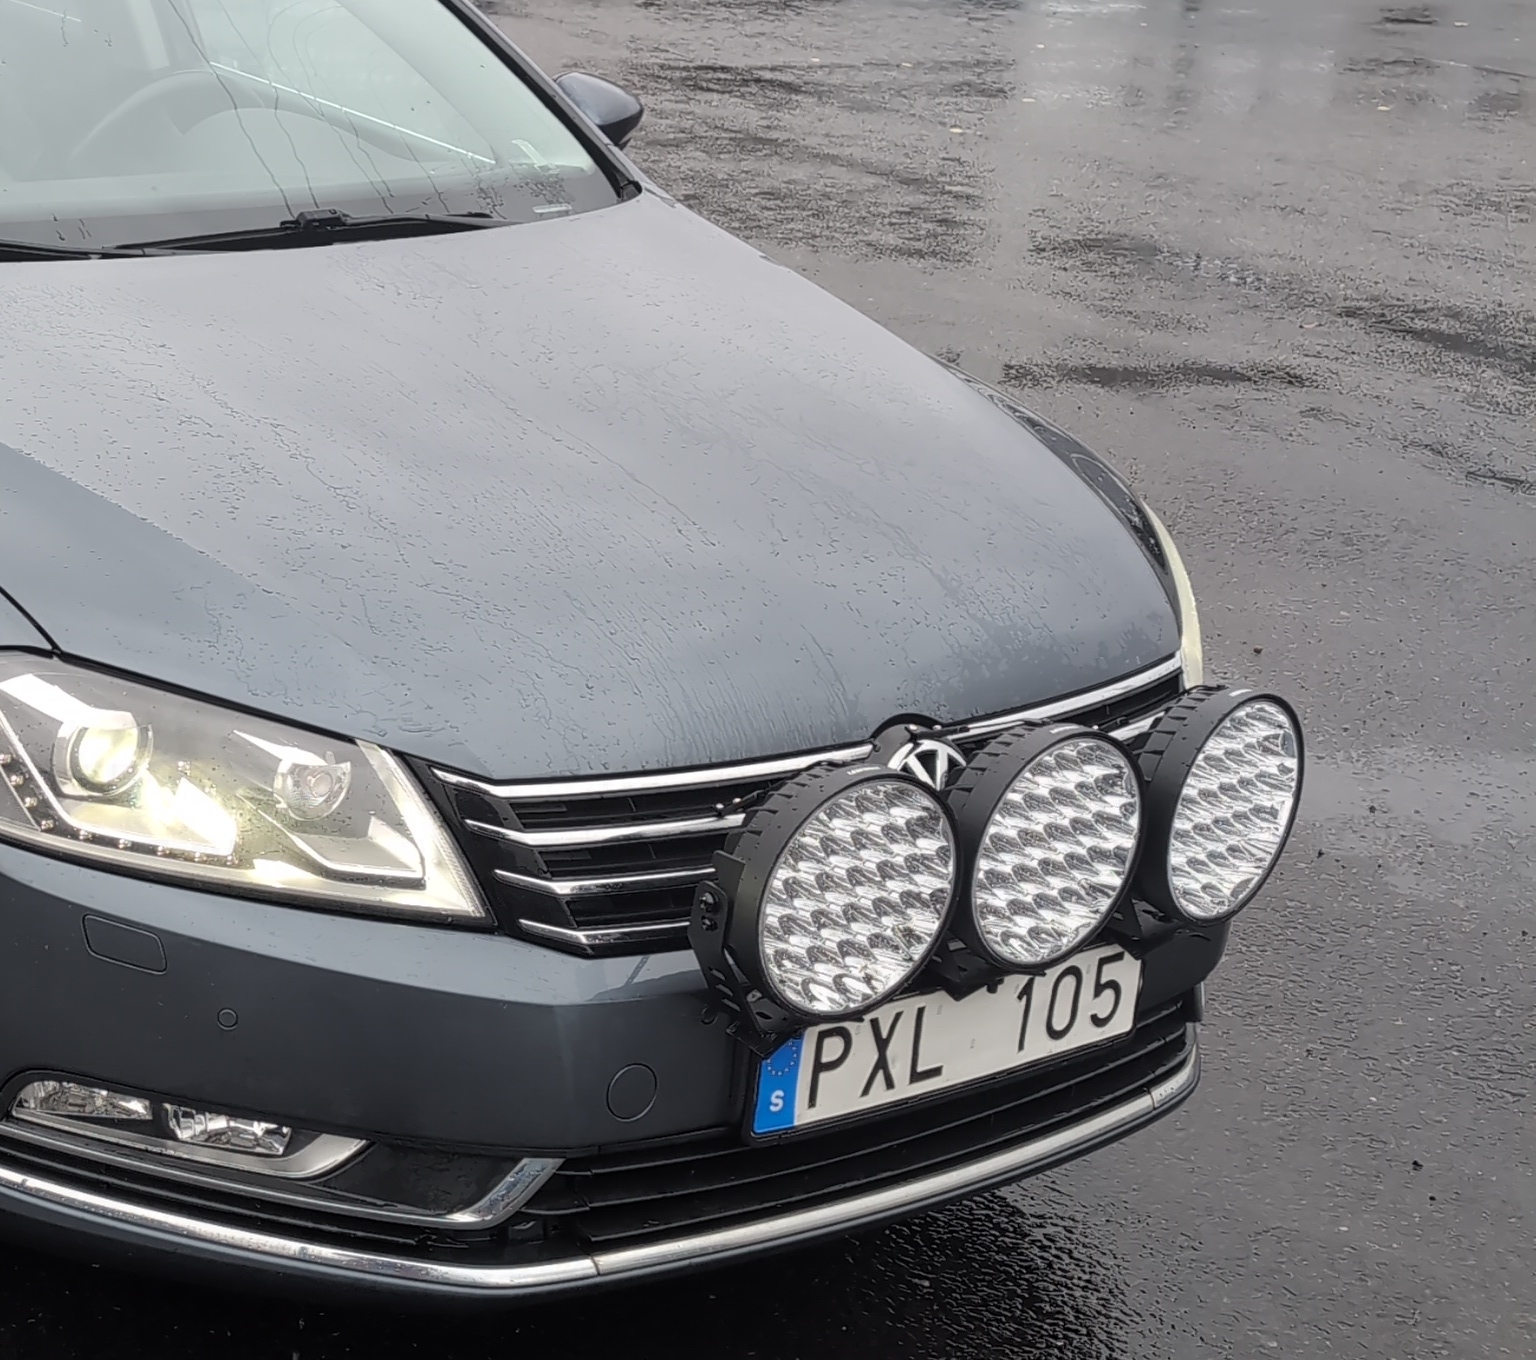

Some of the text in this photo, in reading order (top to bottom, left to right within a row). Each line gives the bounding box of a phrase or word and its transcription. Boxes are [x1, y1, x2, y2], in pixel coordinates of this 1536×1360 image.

[808, 951, 1126, 1109] PXL 105
[769, 1089, 784, 1112] S
